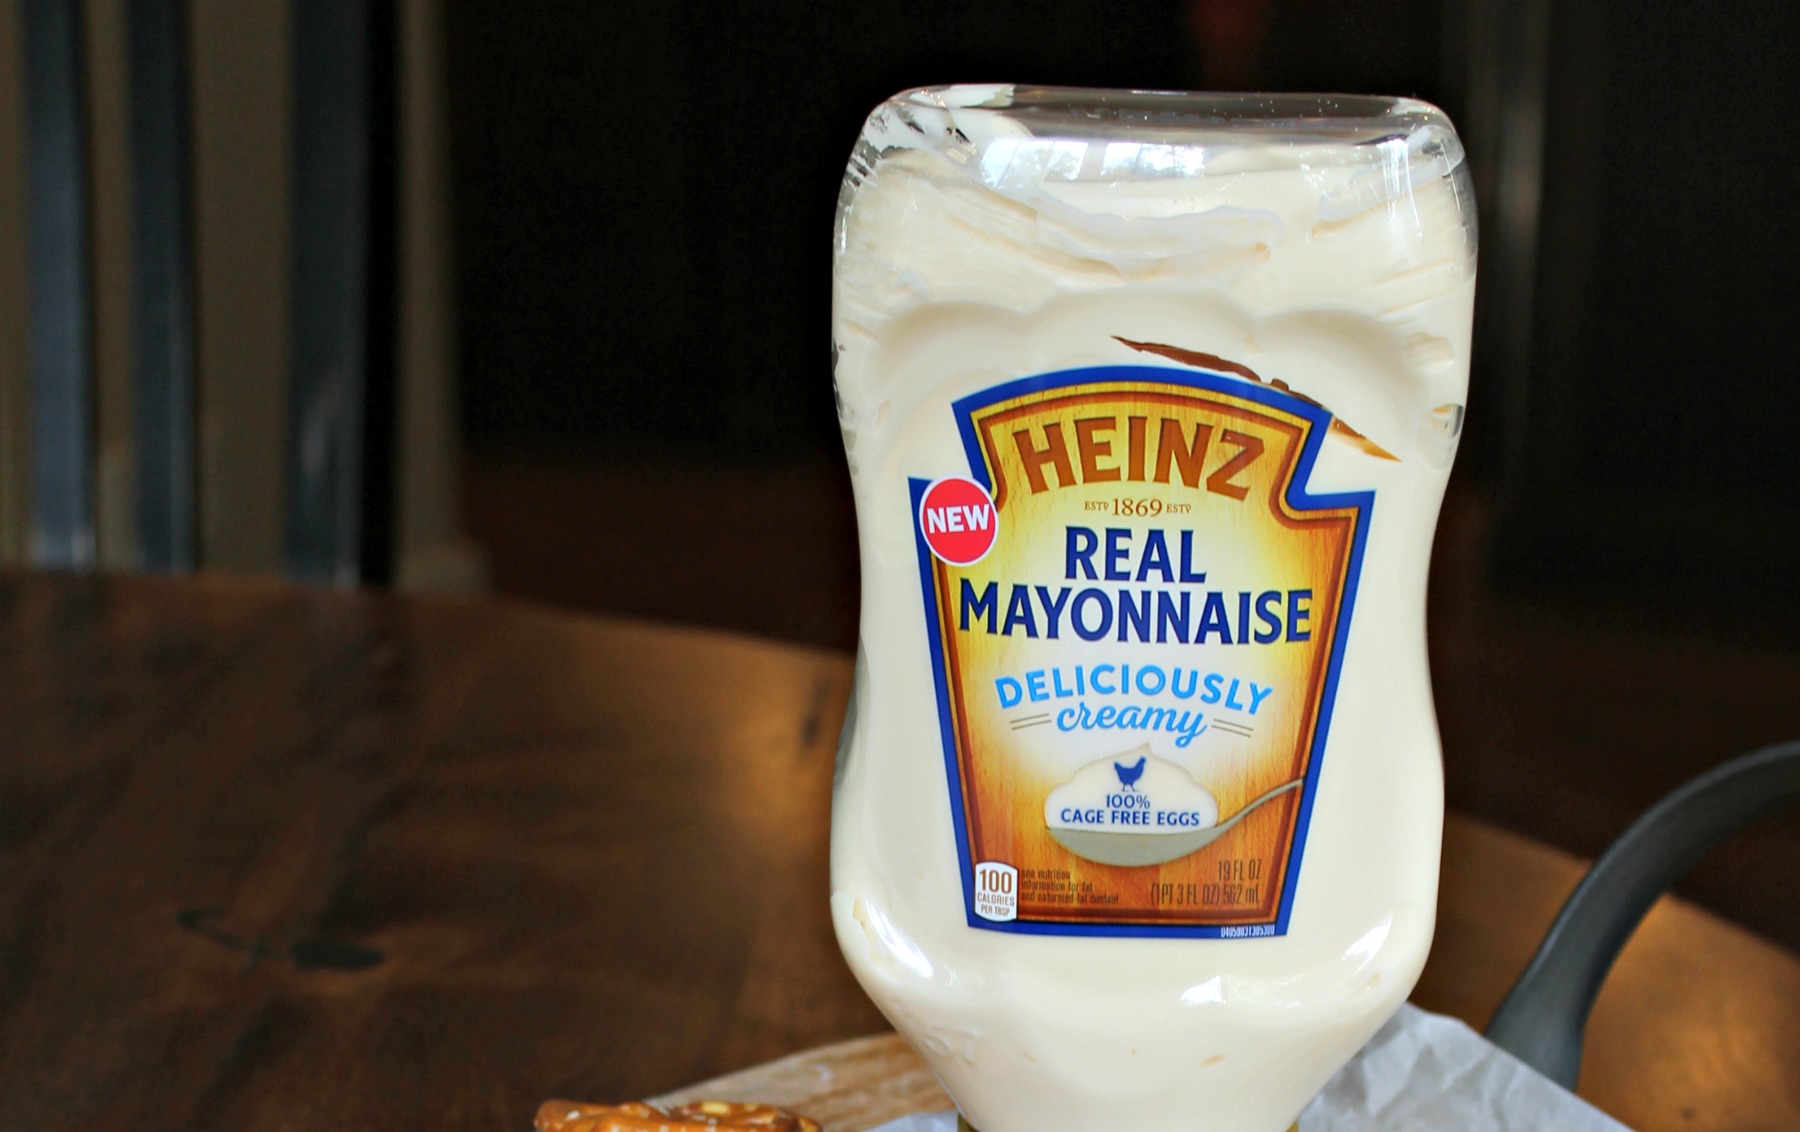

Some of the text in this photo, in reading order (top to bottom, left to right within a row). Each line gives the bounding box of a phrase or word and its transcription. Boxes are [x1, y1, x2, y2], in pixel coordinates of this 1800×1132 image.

[1012, 415, 1265, 500] HEINZ
[1112, 498, 1163, 517] 1869
[926, 504, 989, 535] NEW
[1065, 526, 1207, 584] REAL
[959, 578, 1313, 646] MAYONNAISE
[995, 664, 1273, 715] DELICIOUSLY
[1057, 702, 1208, 748] creamy
[1105, 794, 1151, 810] 100%
[1061, 809, 1200, 827] CAGE FREE EGGS
[979, 869, 1012, 894] 100
[1218, 859, 1262, 881] 19 FL OZ
[977, 892, 1015, 907] CALORIES
[1177, 883, 1184, 905] 3
[1187, 883, 1198, 905] FL
[981, 904, 994, 914] PER
